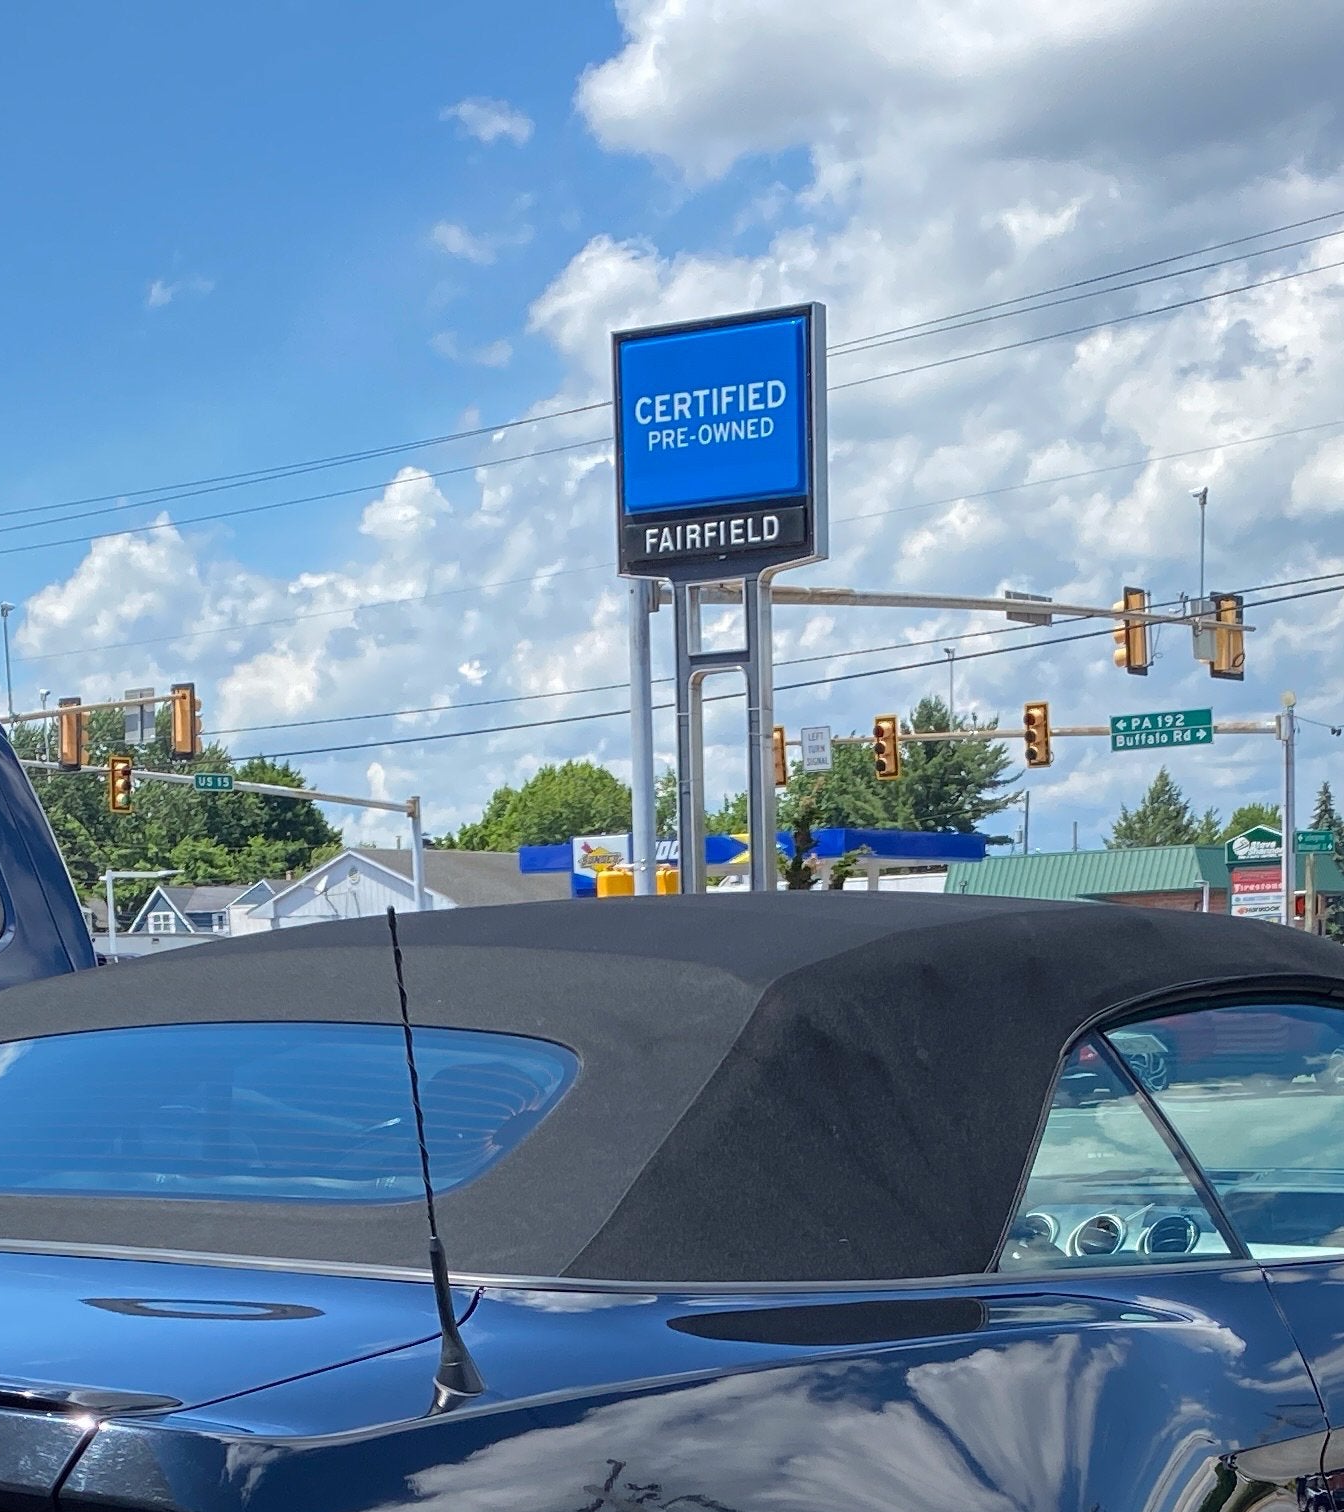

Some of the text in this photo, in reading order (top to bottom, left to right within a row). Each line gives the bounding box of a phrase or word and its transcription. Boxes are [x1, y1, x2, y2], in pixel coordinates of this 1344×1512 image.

[635, 379, 787, 425] CERTIFIED
[648, 417, 774, 451] PRE-OWNED
[645, 515, 779, 554] FAIRFIELD
[1131, 714, 1185, 730] PA 192
[1116, 729, 1192, 747] Buffalo Rd
[198, 776, 230, 787] US 15
